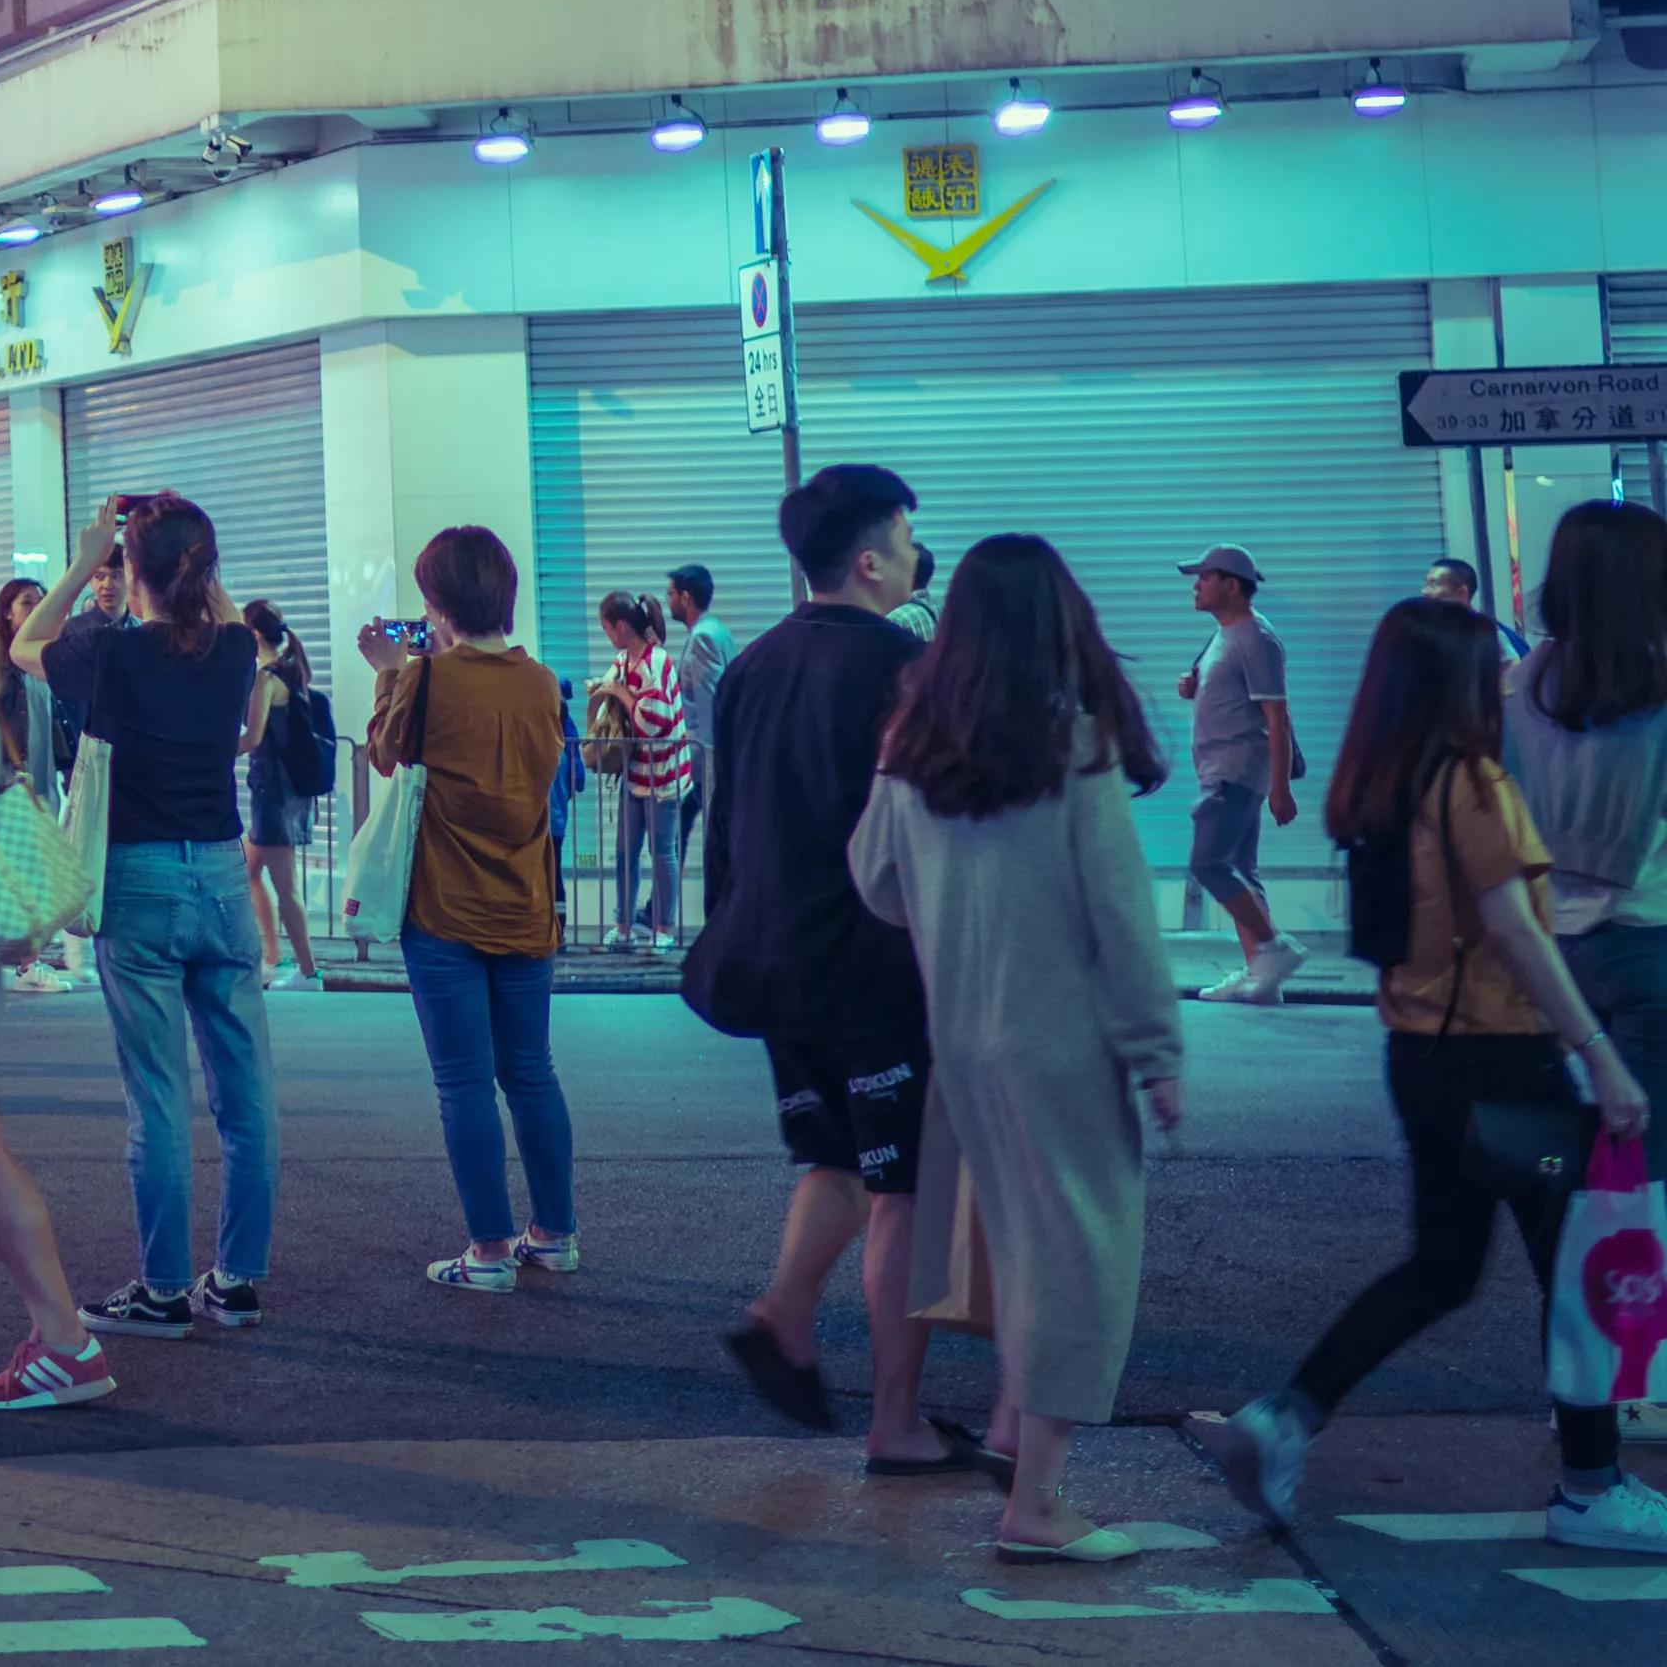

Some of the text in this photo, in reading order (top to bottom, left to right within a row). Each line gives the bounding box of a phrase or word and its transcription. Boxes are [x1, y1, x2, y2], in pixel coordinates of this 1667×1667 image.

[5, 338, 43, 374] LTD.
[749, 348, 778, 374] 24 hrs
[1470, 373, 1660, 398] Carnarvon Road
[755, 383, 777, 418] 全日
[1499, 404, 1637, 433] 加拿分道
